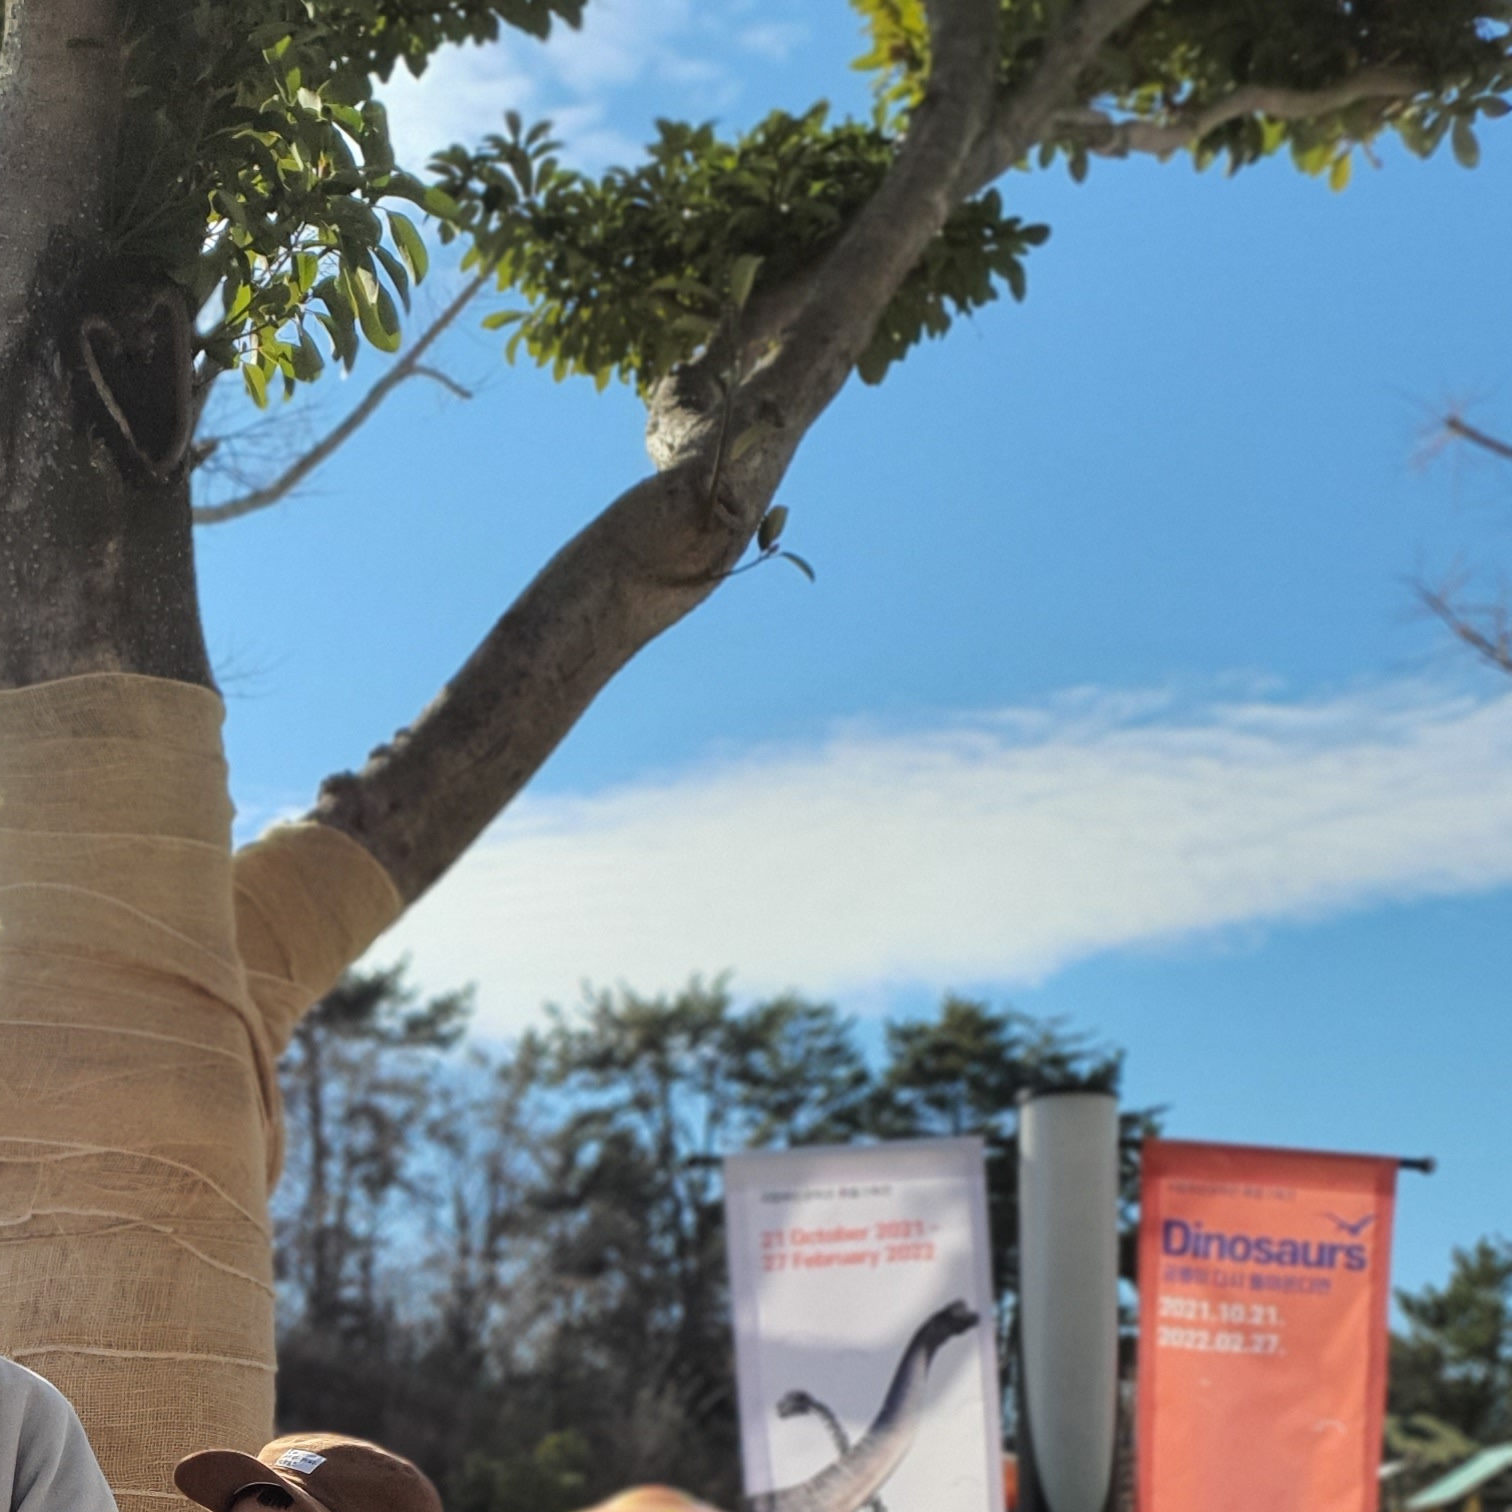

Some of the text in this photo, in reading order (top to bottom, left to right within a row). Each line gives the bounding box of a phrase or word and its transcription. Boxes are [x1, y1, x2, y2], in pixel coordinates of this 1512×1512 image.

[790, 1227, 868, 1245] October
[876, 1220, 925, 1239] 2021
[1162, 1218, 1368, 1273] Dinosaurs
[792, 1250, 879, 1269] February
